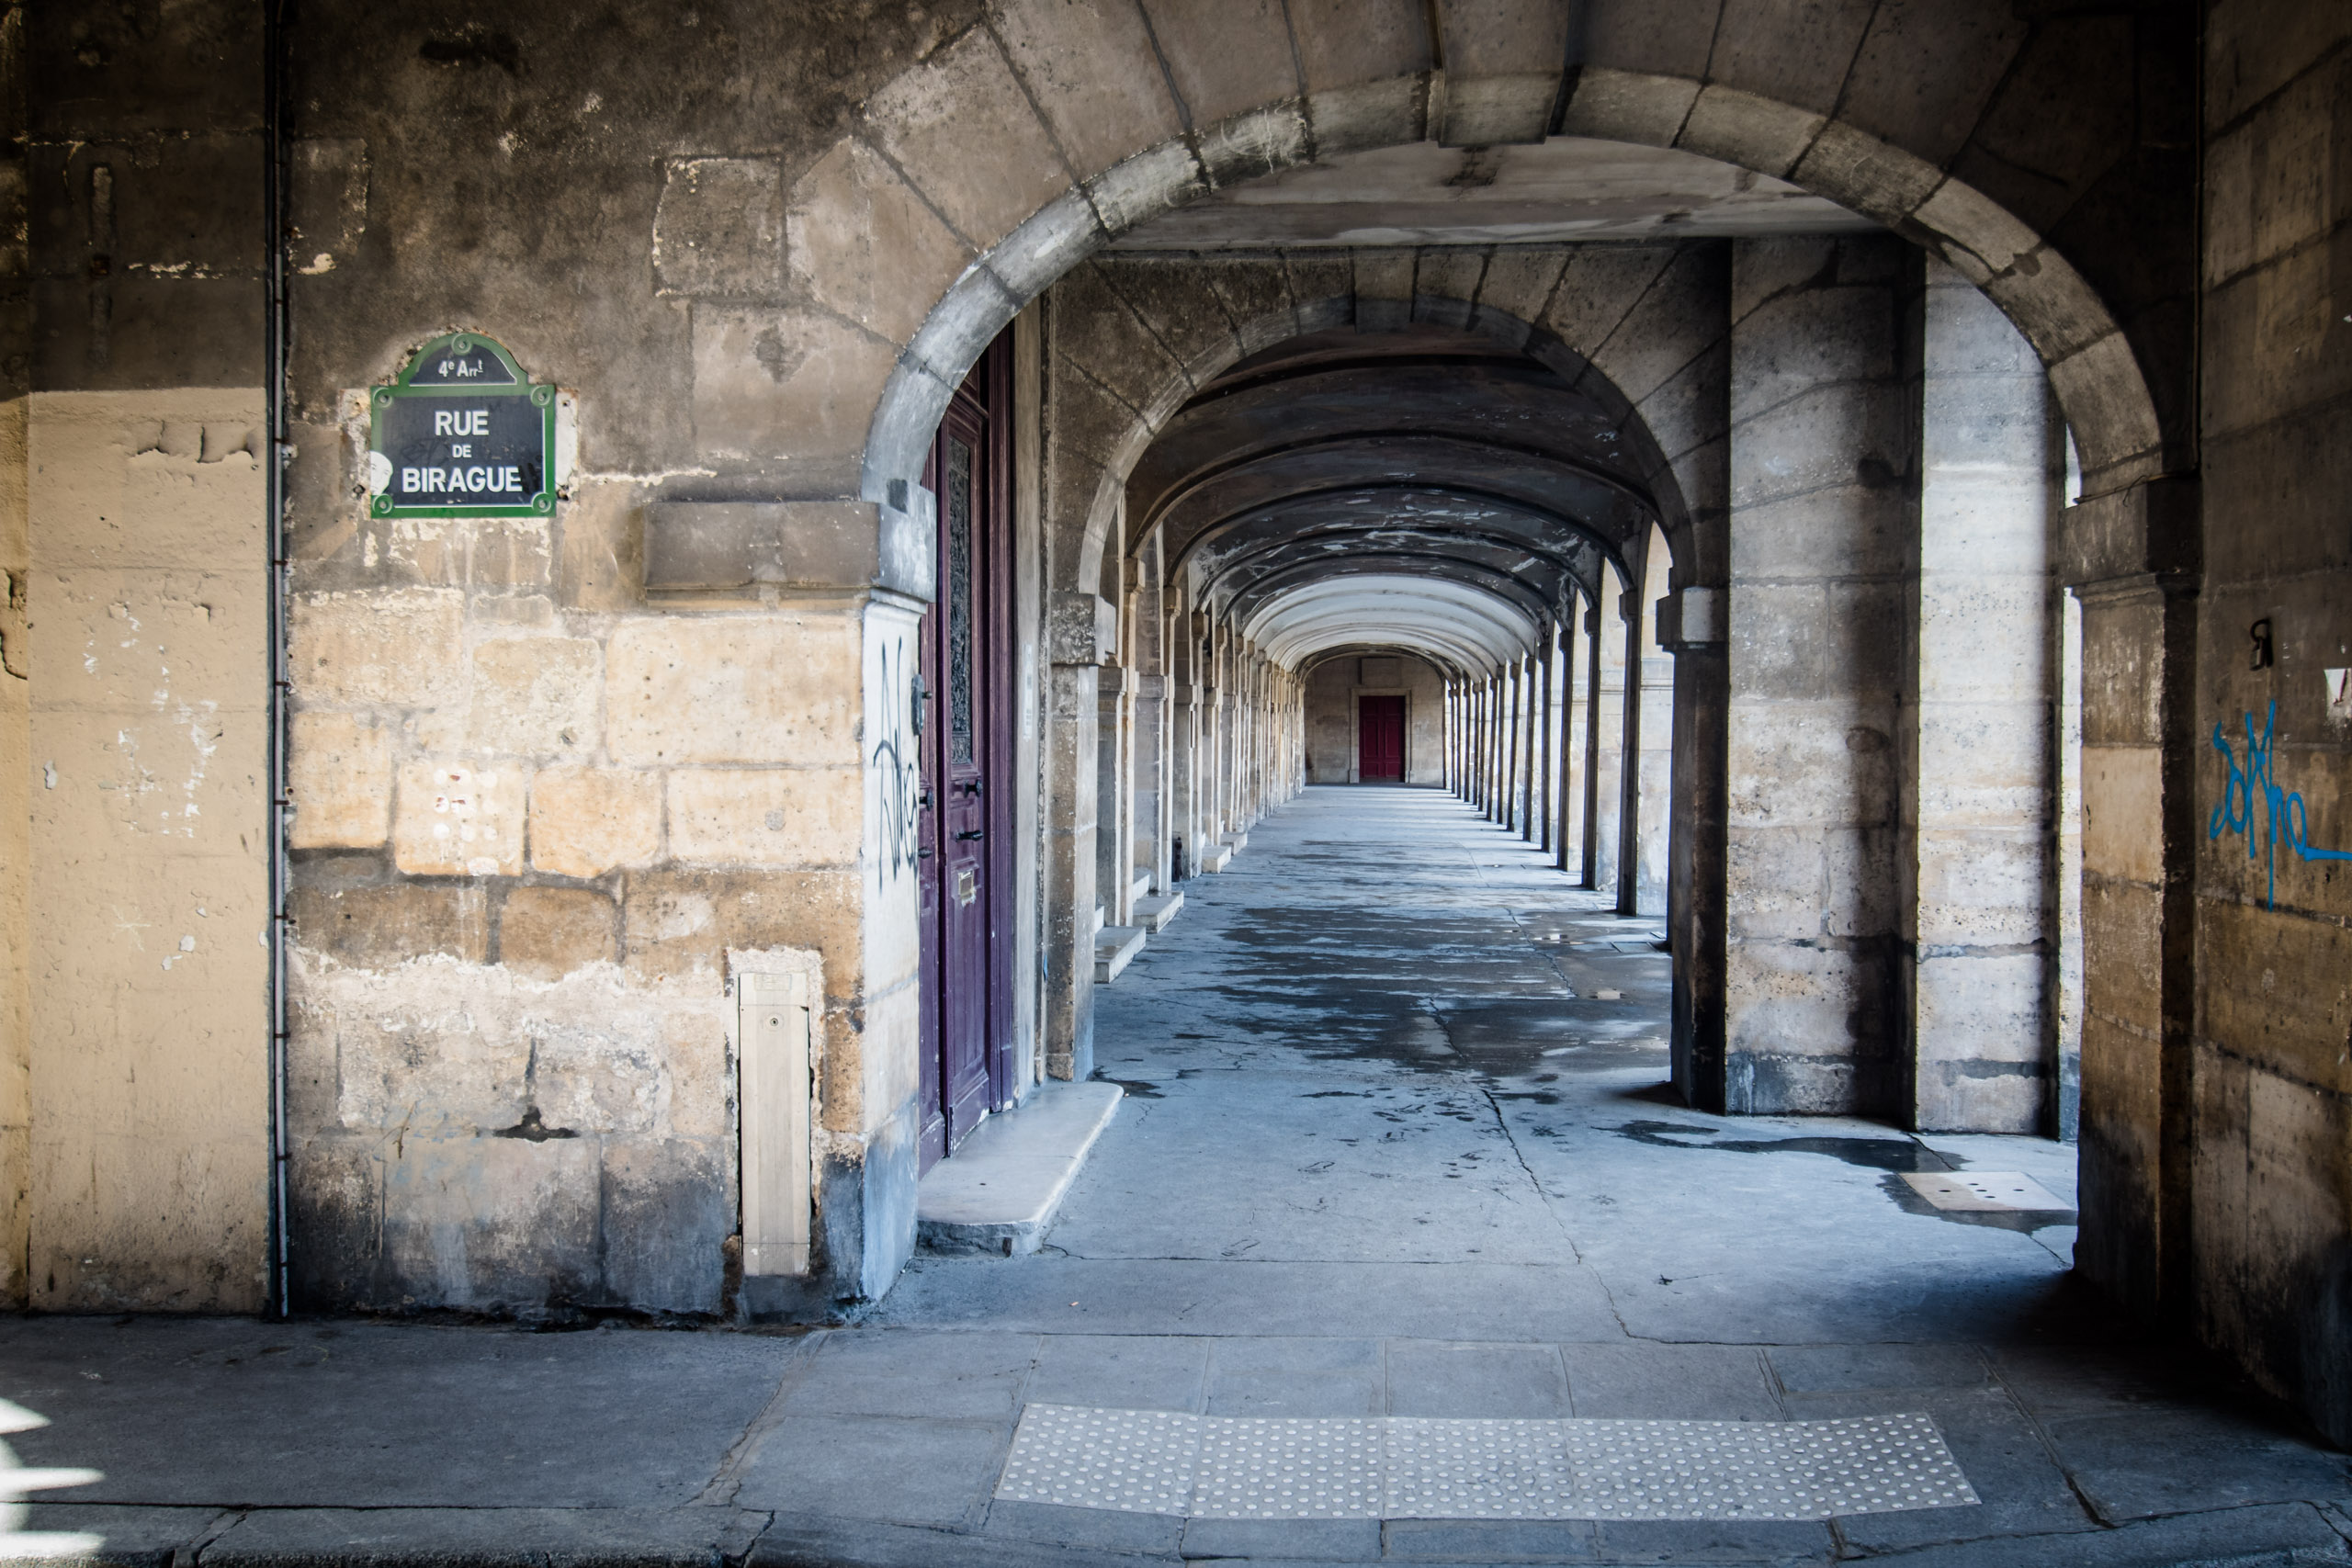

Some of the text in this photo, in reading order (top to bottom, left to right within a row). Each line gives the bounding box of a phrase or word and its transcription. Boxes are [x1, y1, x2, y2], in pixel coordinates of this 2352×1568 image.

[435, 411, 489, 436] RUE
[452, 444, 472, 458] DE
[401, 466, 523, 493] BIRAGUE
